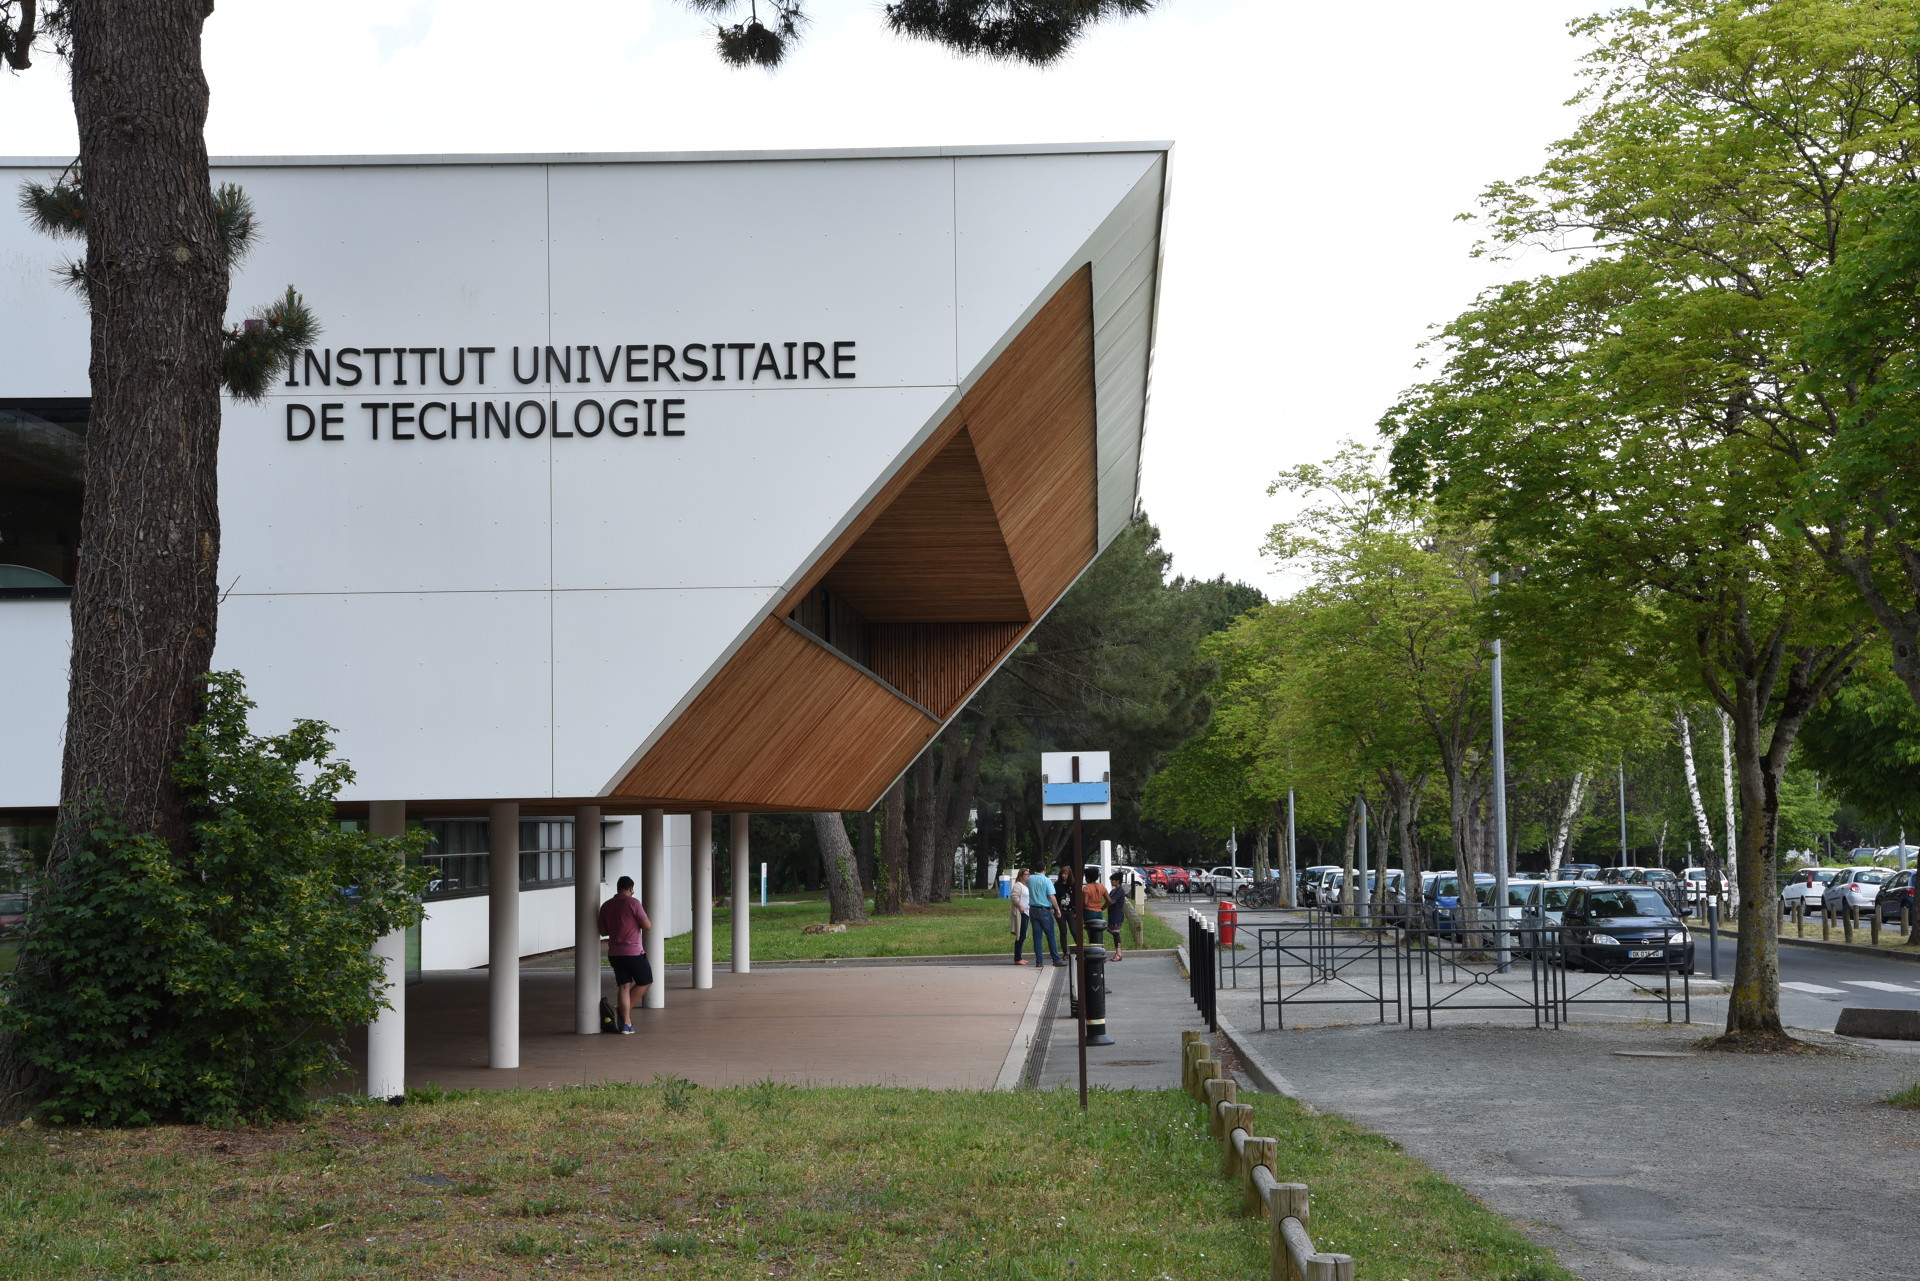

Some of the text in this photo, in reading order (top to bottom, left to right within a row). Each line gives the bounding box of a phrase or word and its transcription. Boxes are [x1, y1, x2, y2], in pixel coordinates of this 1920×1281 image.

[285, 341, 856, 388] INSTITUT UNIVERSITAIRE
[286, 399, 686, 441] DE TECHNOLOGIE
